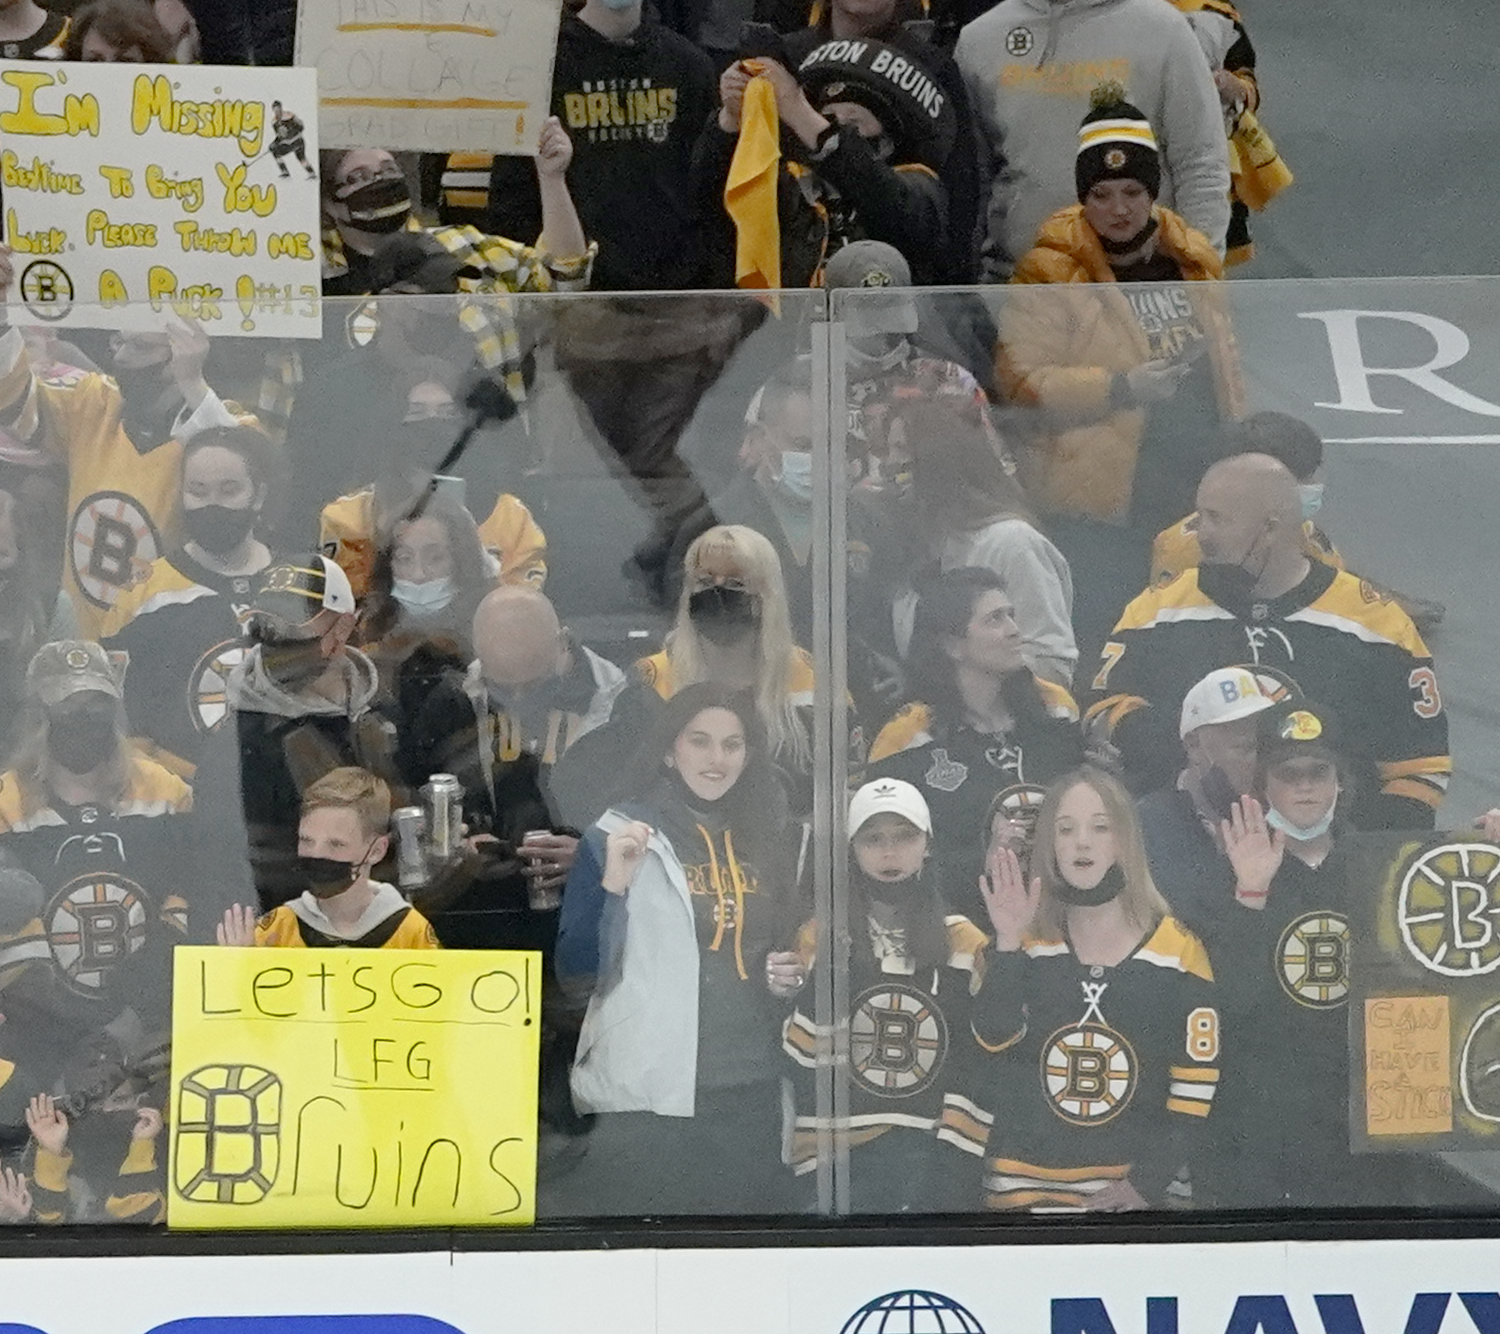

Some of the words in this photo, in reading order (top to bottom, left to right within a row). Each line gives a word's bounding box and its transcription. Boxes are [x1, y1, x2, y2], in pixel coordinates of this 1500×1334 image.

[564, 88, 678, 129] BRUINS
[802, 44, 865, 70] STON
[872, 48, 945, 119] BRUINS
[100, 269, 128, 309] A
[1297, 308, 1500, 417] R
[89, 517, 139, 587] B
[1091, 642, 1126, 690] 7
[1408, 665, 1442, 719] 3
[1452, 880, 1492, 949] B
[333, 1038, 431, 1082] LFG
[876, 1013, 920, 1068] B
[1187, 1008, 1220, 1063] 8
[1068, 1044, 1110, 1099] B
